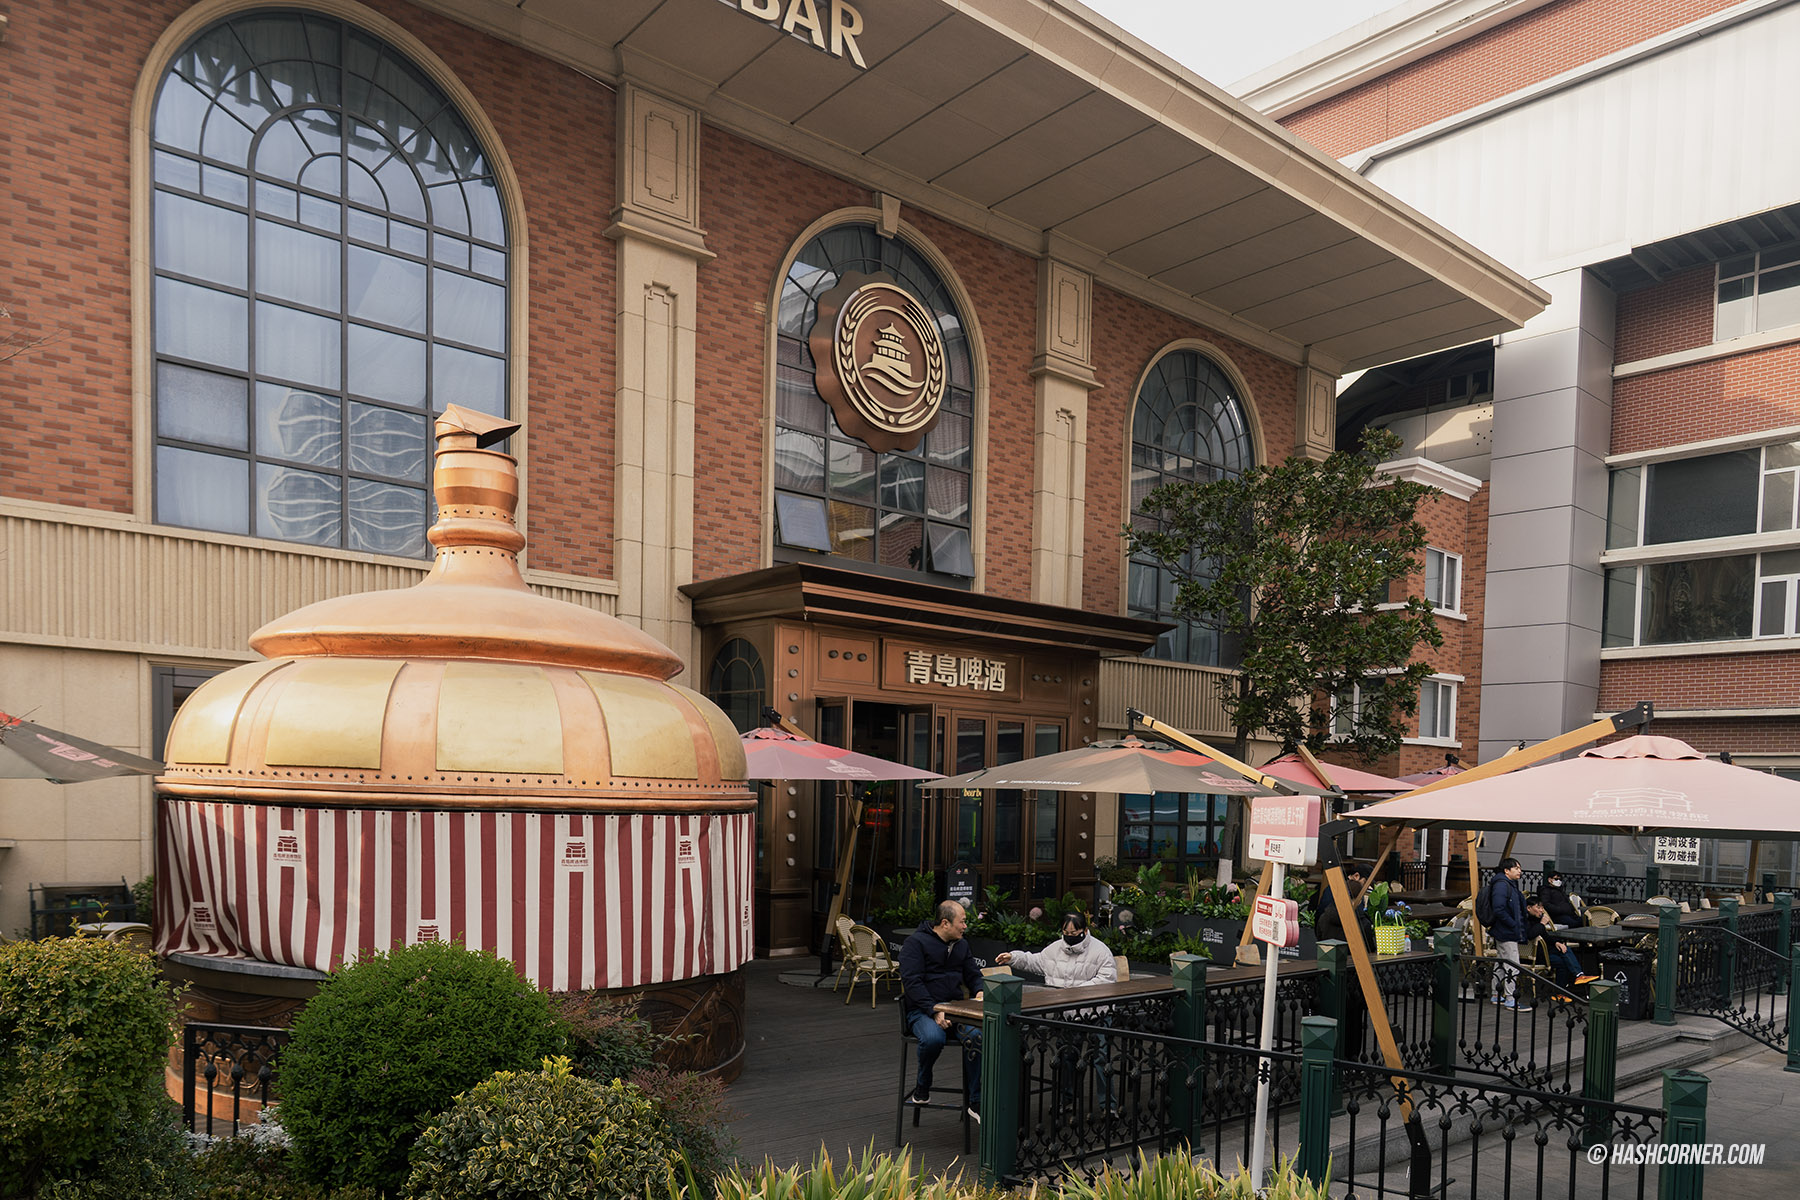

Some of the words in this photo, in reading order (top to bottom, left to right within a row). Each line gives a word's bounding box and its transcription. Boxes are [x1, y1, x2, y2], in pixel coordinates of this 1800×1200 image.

[1658, 835, 1698, 849] 空调设备
[1657, 849, 1698, 863] 请勿碰撞
